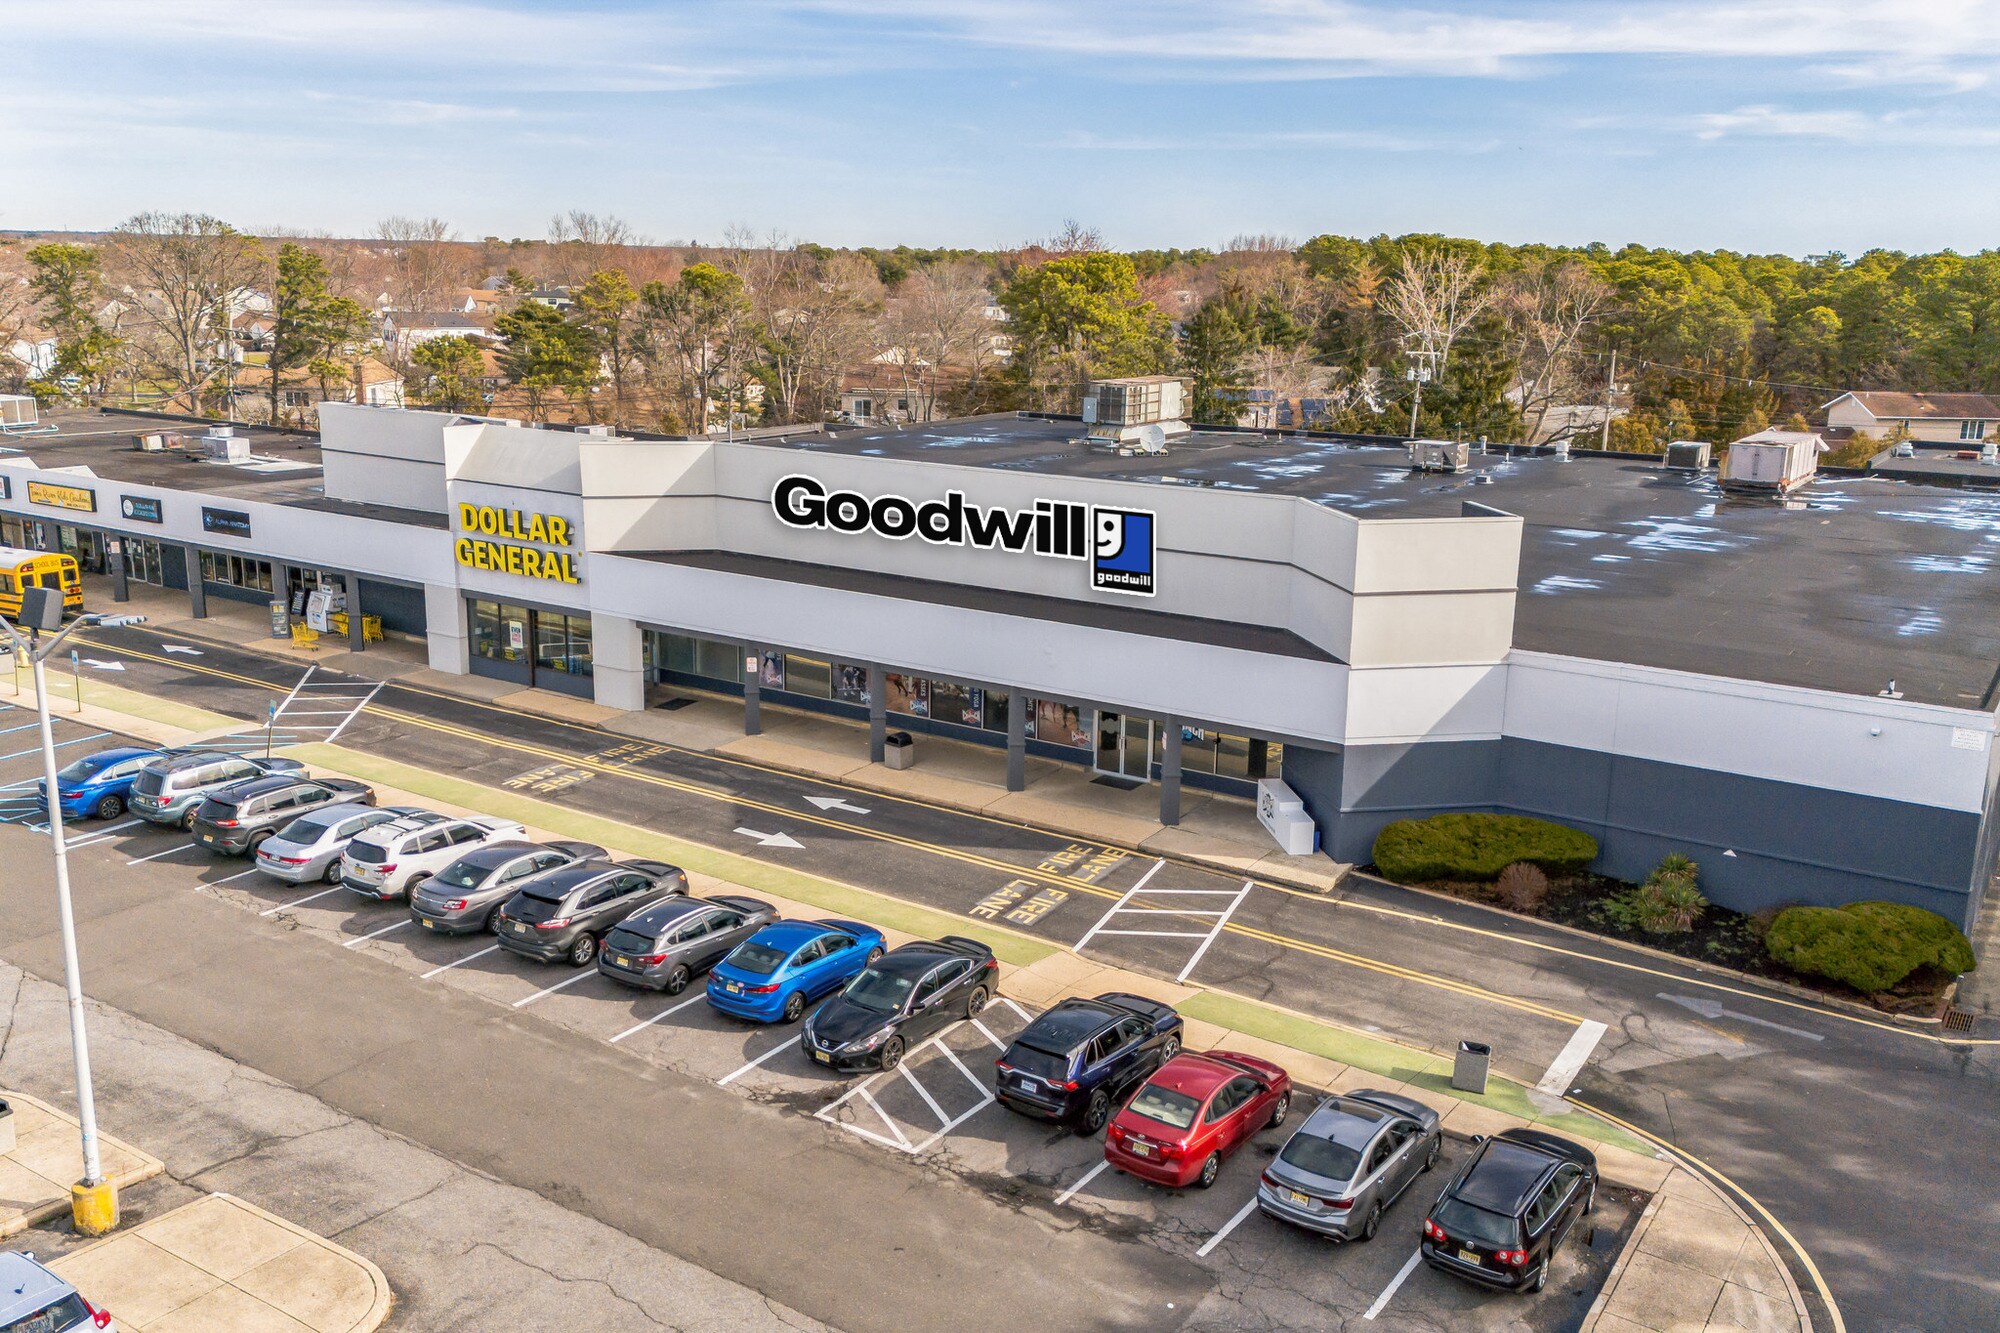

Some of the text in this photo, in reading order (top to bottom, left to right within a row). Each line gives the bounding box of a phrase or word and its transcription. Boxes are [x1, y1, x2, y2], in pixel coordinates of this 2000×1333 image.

[458, 502, 573, 547] DOLLAR
[773, 476, 1087, 558] Goodwill
[455, 537, 582, 584] GENERAL
[1097, 572, 1151, 586] goodwill
[1036, 844, 1093, 874] FIRE
[1067, 846, 1128, 883] LANE
[968, 879, 1038, 919] LANE
[1006, 888, 1069, 925] FIRE
